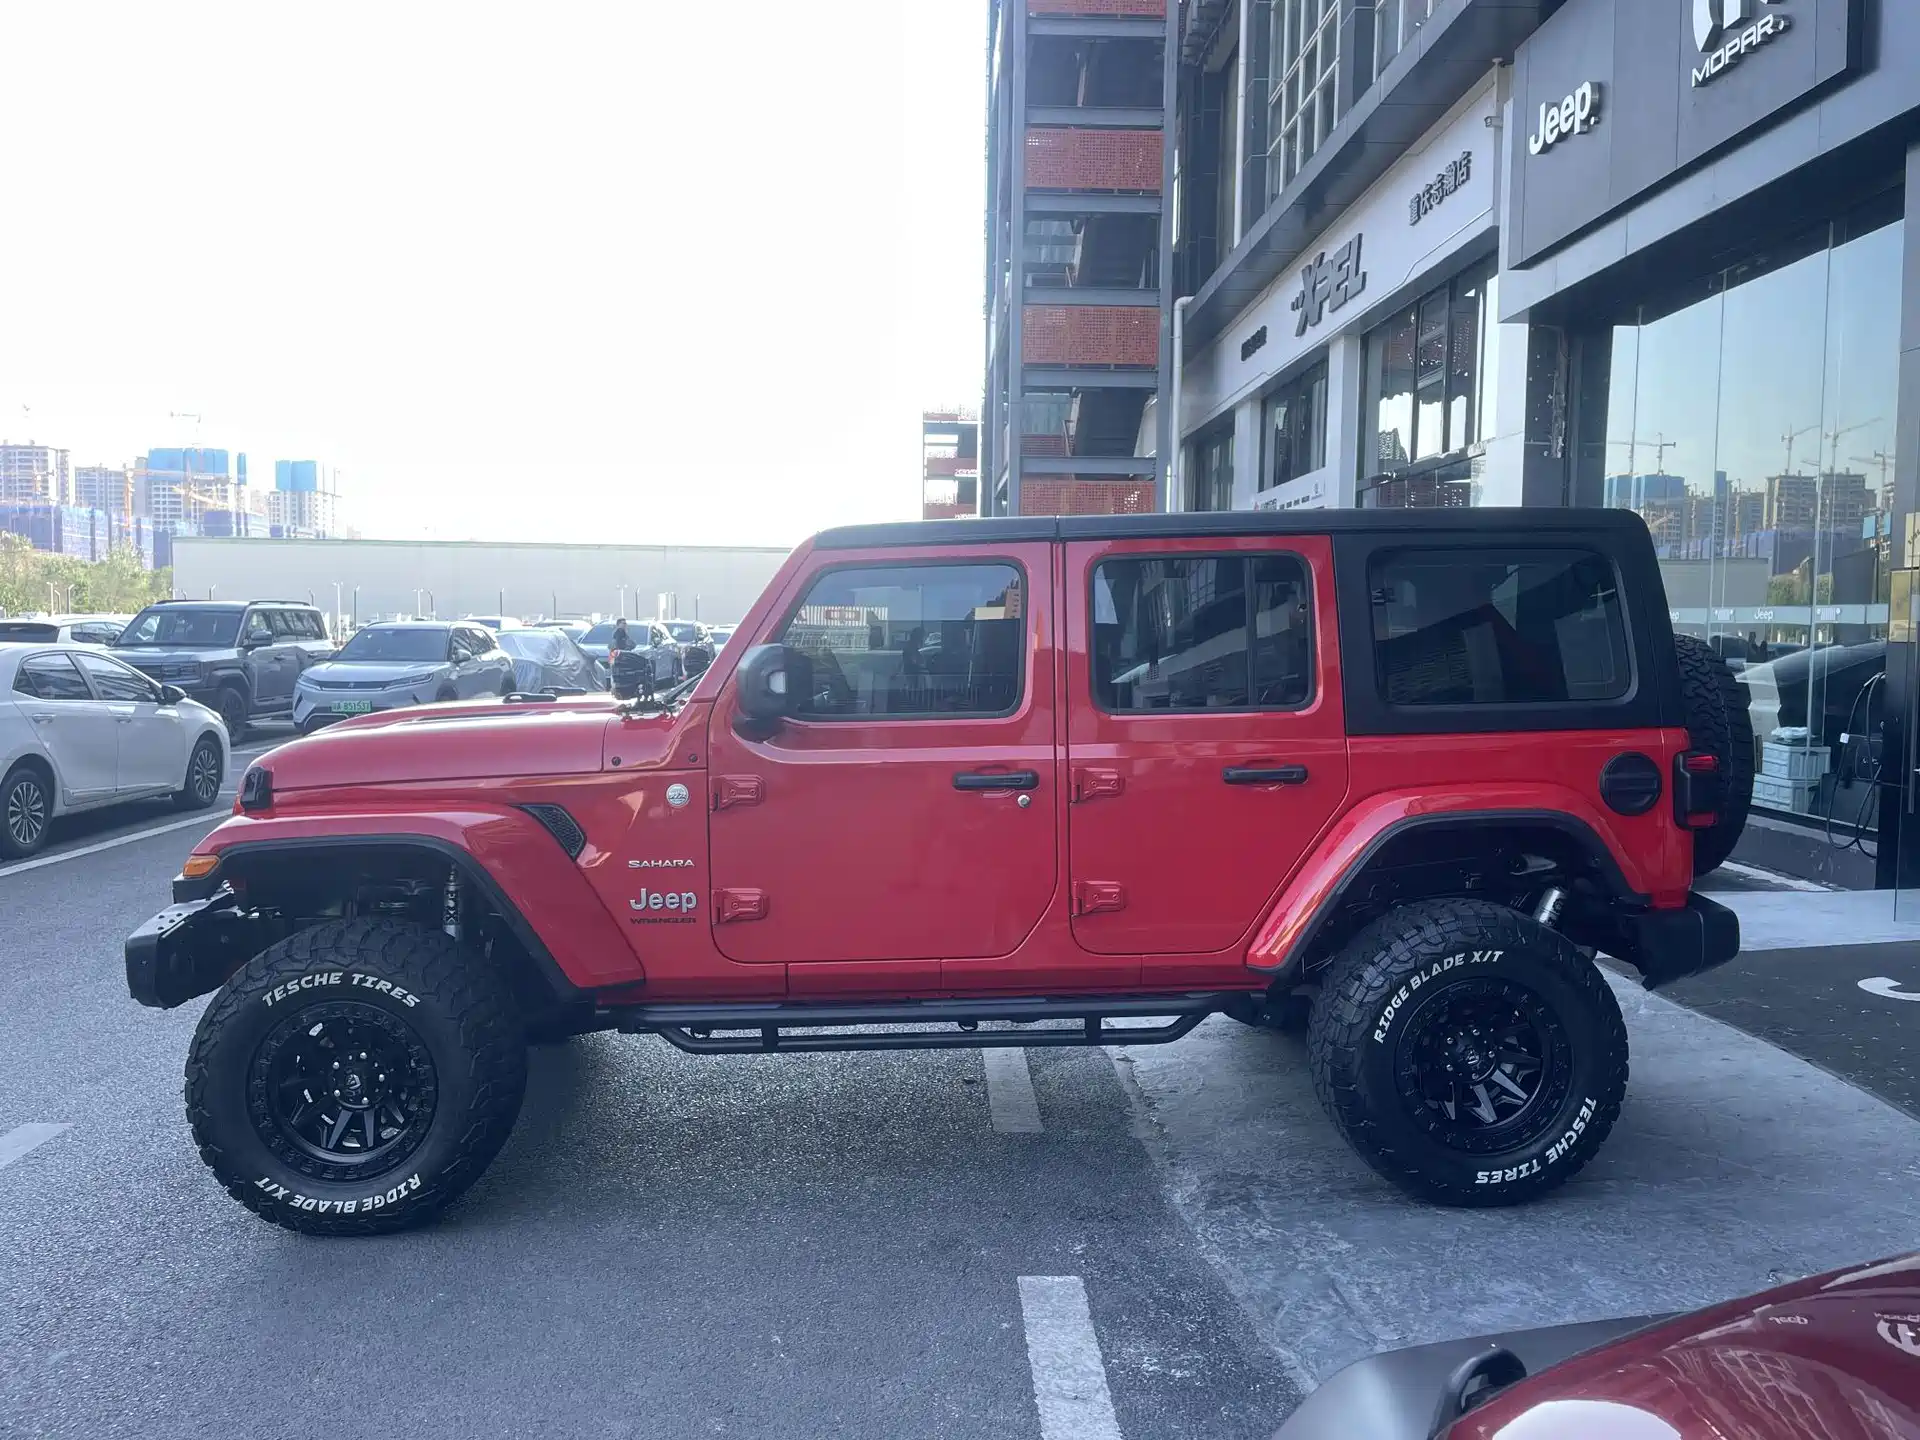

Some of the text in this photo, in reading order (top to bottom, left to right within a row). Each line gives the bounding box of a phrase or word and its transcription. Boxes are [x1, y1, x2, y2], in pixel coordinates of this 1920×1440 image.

[1294, 232, 1367, 338] XPEL
[1754, 608, 1774, 621] Jeep
[628, 859, 695, 868] SAHARA
[630, 888, 697, 913] Jeep
[262, 972, 420, 1008] TESCHE TIRES
[1373, 950, 1505, 1044] RIDGE BLADE X/T
[1474, 1096, 1597, 1184] TESCHE TIRES
[253, 1173, 422, 1214] RIDGE BLADE X/T
